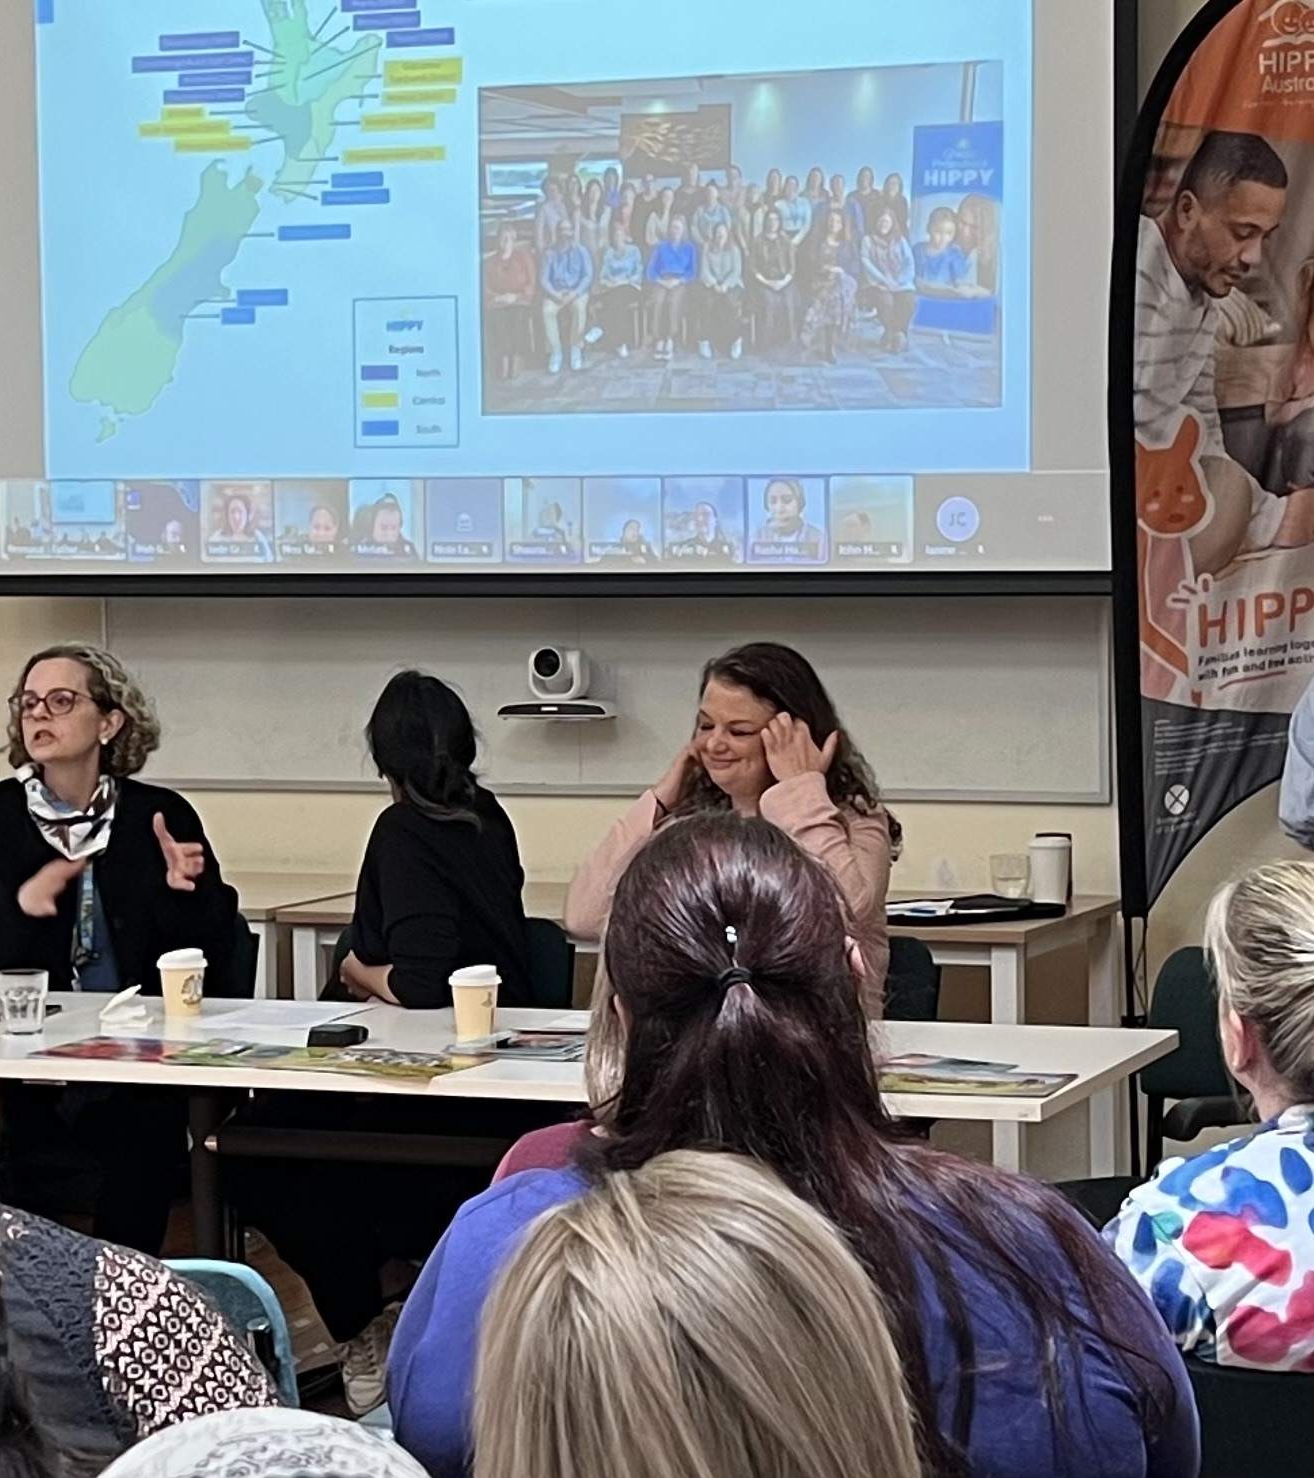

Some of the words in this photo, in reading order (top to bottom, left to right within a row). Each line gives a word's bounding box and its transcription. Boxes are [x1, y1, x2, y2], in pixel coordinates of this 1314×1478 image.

[1259, 50, 1314, 74] HIPP
[923, 168, 995, 187] HIPPY
[949, 511, 967, 527] JC
[1198, 587, 1314, 648] HIPP
[1242, 661, 1266, 673] and
